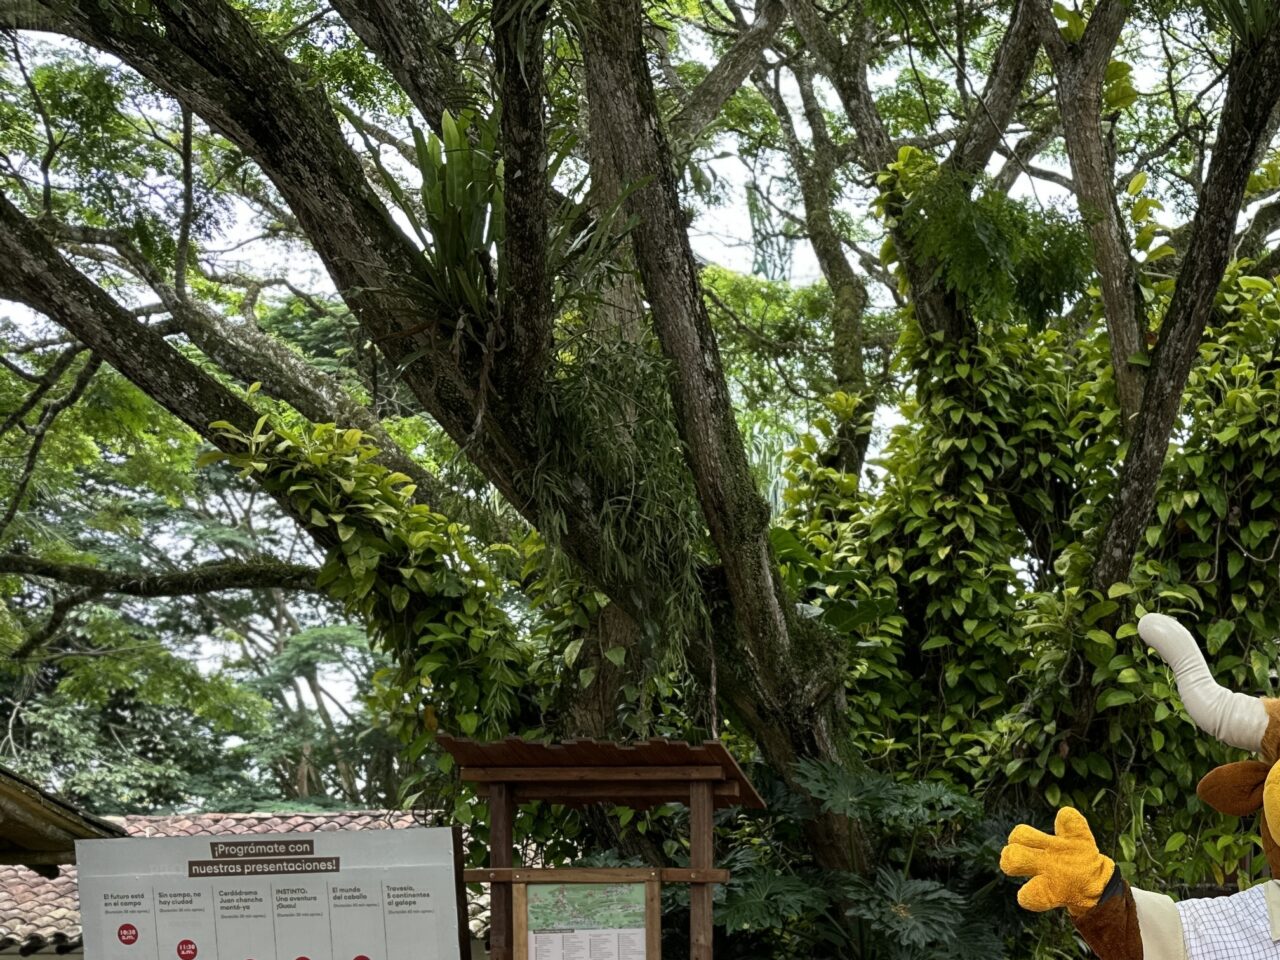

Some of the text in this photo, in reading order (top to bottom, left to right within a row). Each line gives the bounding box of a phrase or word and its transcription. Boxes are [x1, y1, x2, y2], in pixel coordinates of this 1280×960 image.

[214, 842, 310, 857] ¡Prográmate con
[192, 859, 336, 874] nuestras presentaciones!
[168, 892, 193, 900] campo,
